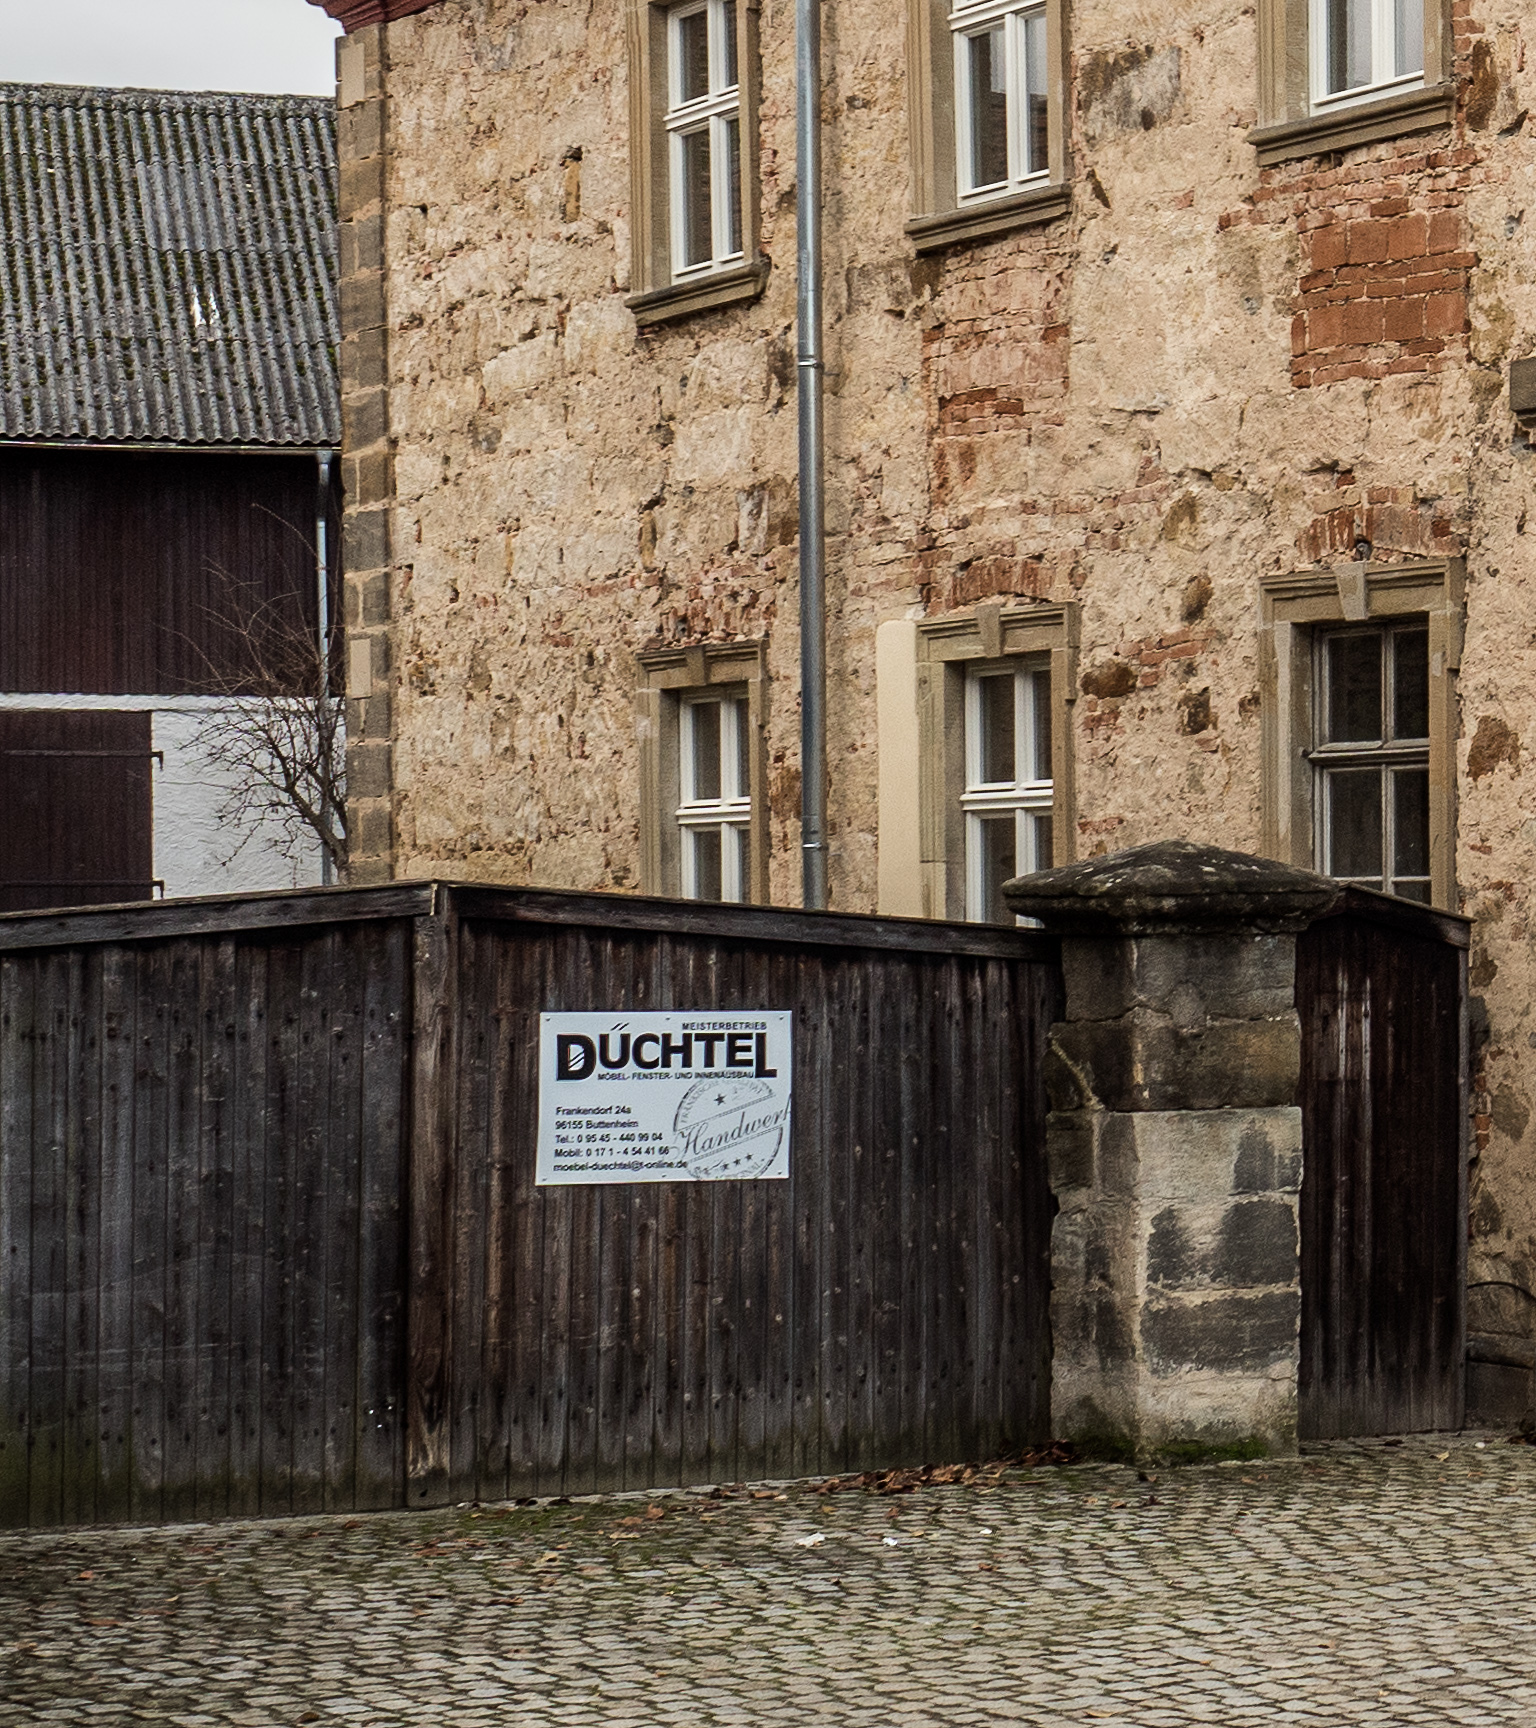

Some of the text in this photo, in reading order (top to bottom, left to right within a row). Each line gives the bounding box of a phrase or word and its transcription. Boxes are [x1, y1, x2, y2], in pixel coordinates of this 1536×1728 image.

[682, 1022, 767, 1030] MEISTERBETRIEB
[556, 1022, 778, 1081] DÜCHTEL
[695, 1071, 754, 1079] INNENAUSBAU
[556, 1105, 631, 1115] Frankendorf 24a
[555, 1119, 639, 1129] 96155 Buttenheim
[554, 1148, 583, 1158] Mobil:
